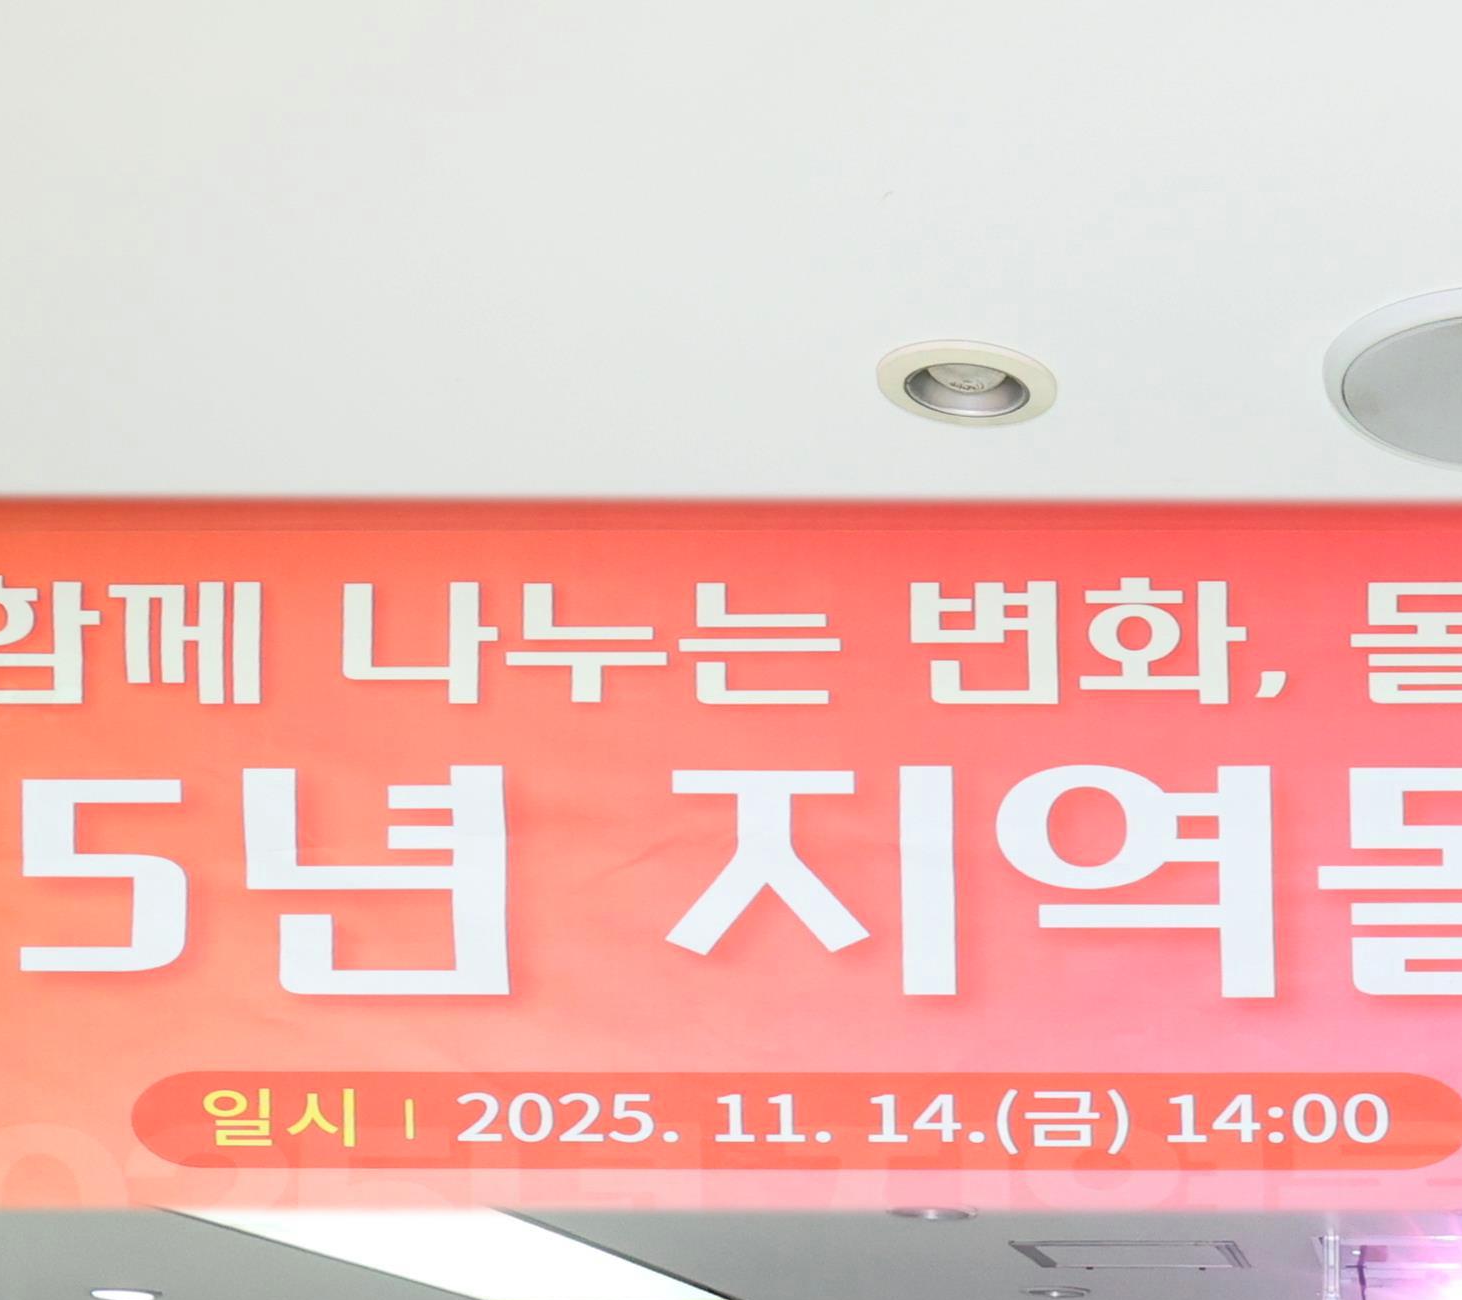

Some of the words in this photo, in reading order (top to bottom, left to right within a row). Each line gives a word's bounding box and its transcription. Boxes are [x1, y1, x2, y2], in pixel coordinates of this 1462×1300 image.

[342, 582, 841, 705] 나누는
[910, 577, 1288, 706] 변화,
[203, 1088, 356, 1148] 일시
[457, 1092, 679, 1144] 2025.
[715, 1094, 832, 1143] 11.
[879, 1089, 1130, 1154] 14.(금)
[1167, 1093, 1389, 1143] 14:00
